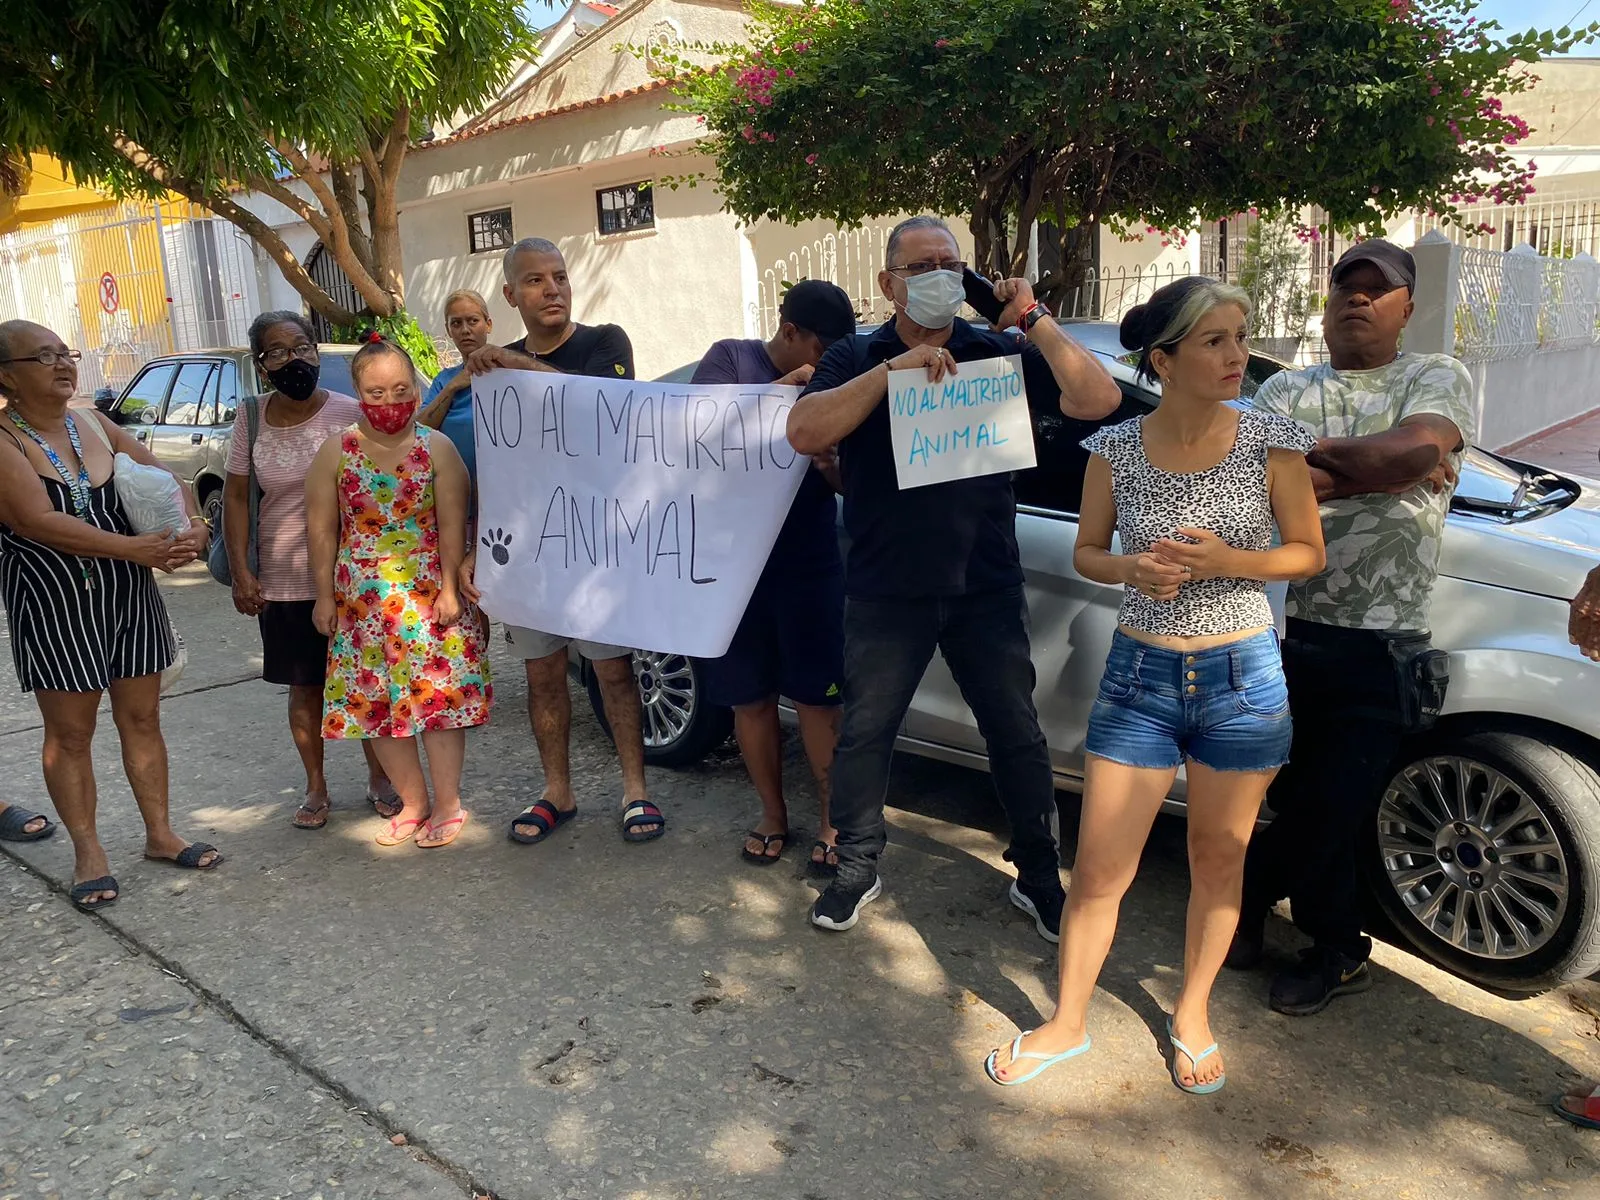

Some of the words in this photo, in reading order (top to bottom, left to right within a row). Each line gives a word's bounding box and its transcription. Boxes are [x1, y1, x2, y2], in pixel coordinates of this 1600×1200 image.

[893, 387, 917, 417] NO
[920, 388, 938, 413] AL
[940, 371, 1021, 409] MALTRATO
[474, 385, 522, 449] NO
[541, 385, 580, 457] AL
[597, 390, 796, 472] MALTRATO
[909, 422, 1009, 467] ANIMAL
[55, 461, 83, 501] YAMAHA
[534, 486, 717, 584] ANIMAL
